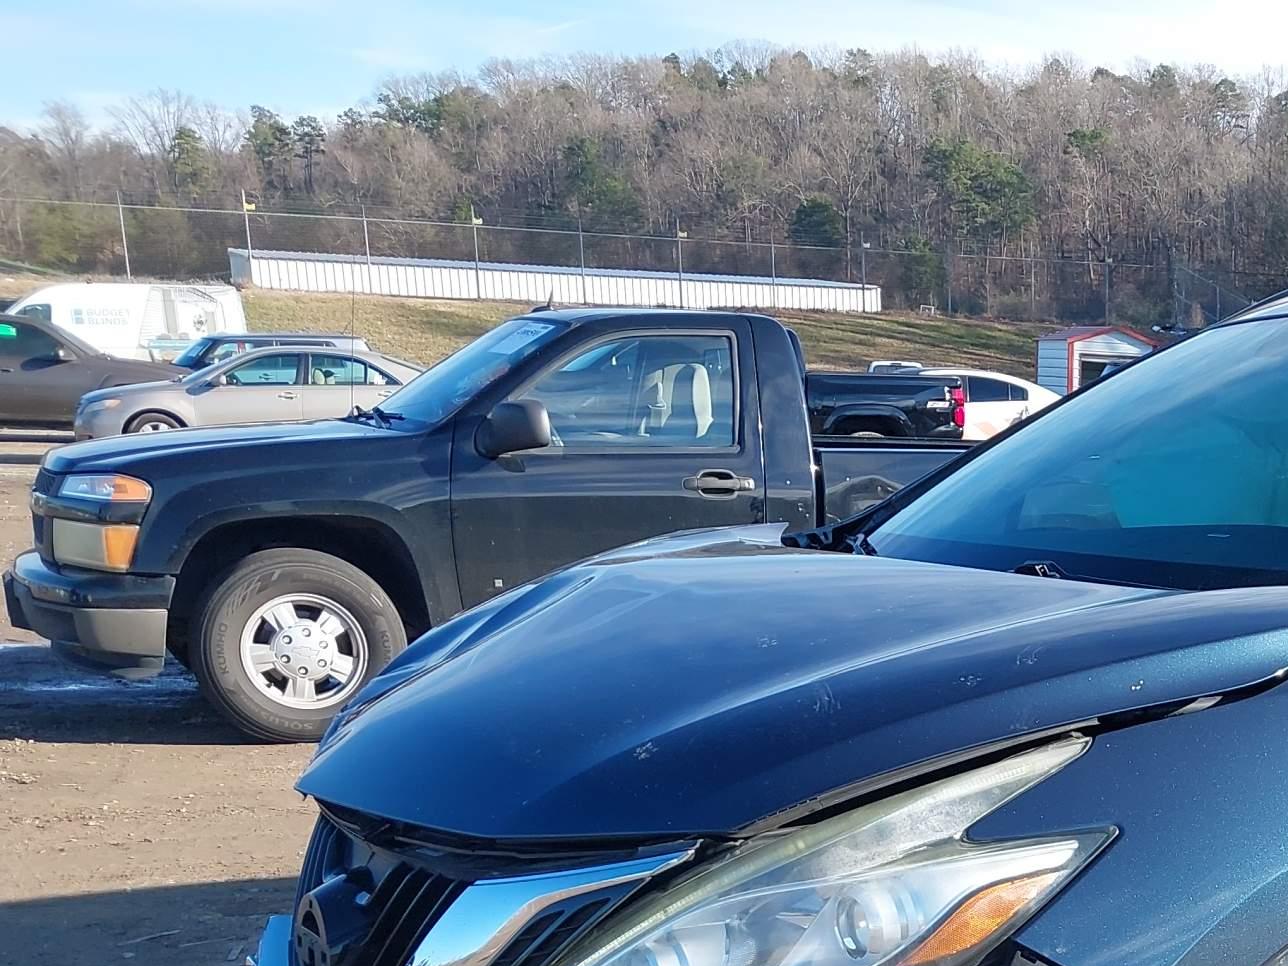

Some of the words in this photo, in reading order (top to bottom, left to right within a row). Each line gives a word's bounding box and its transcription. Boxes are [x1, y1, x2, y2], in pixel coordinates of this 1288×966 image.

[86, 308, 130, 317] BUDGET
[87, 317, 129, 325] BLINDS
[217, 622, 229, 675] KUMHO
